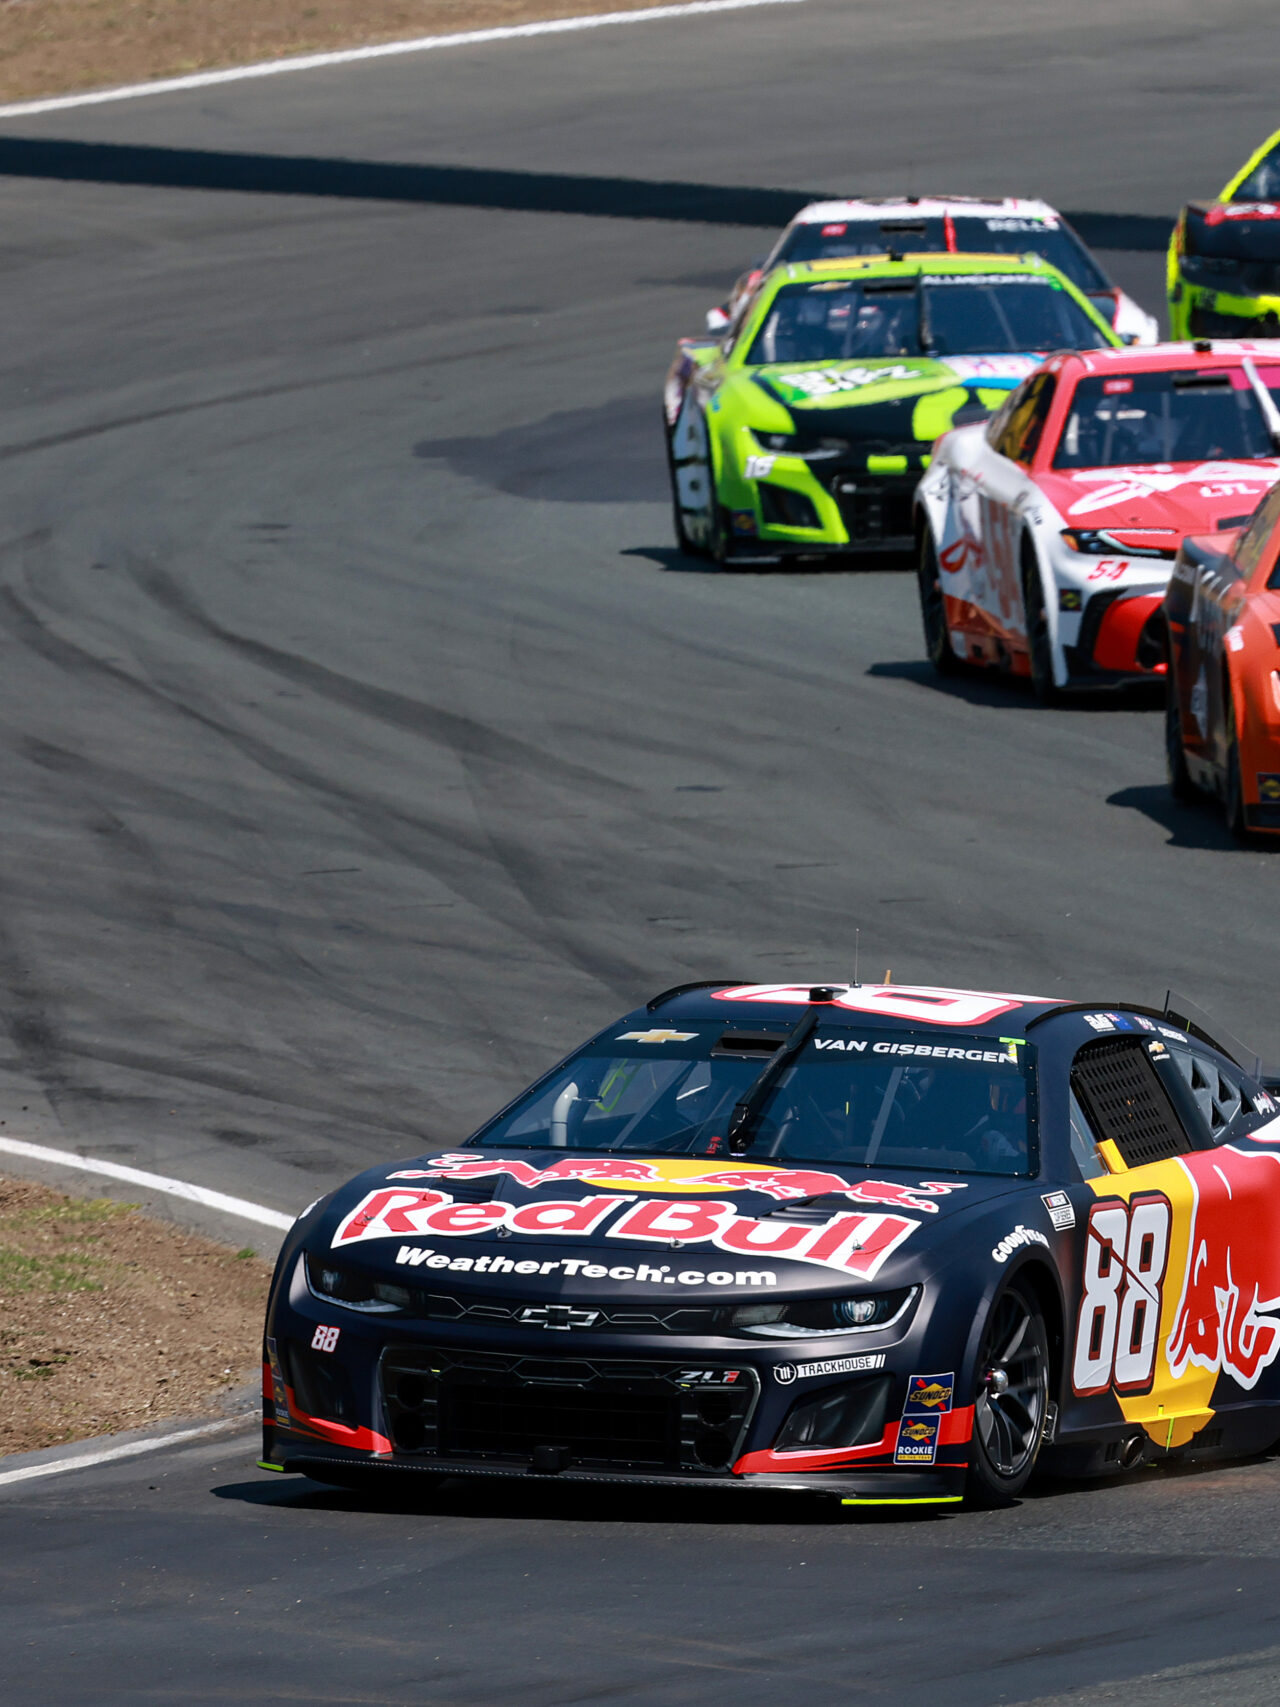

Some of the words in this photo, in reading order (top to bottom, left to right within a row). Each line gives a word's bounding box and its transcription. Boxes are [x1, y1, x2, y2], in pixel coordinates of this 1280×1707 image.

[813, 1038, 868, 1052] VAN
[872, 1041, 1018, 1065] GISBERGEN
[331, 1186, 637, 1249] Red
[605, 1198, 923, 1282] Bull
[991, 1224, 1050, 1263] GOODYEAR
[1072, 1194, 1172, 1398] 88
[311, 1324, 341, 1353] 88
[801, 1356, 872, 1376] TRACKHOUSE
[909, 1387, 952, 1402] SUNOCO
[902, 1426, 936, 1437] SUNOCO
[897, 1446, 933, 1454] ROOKIE
